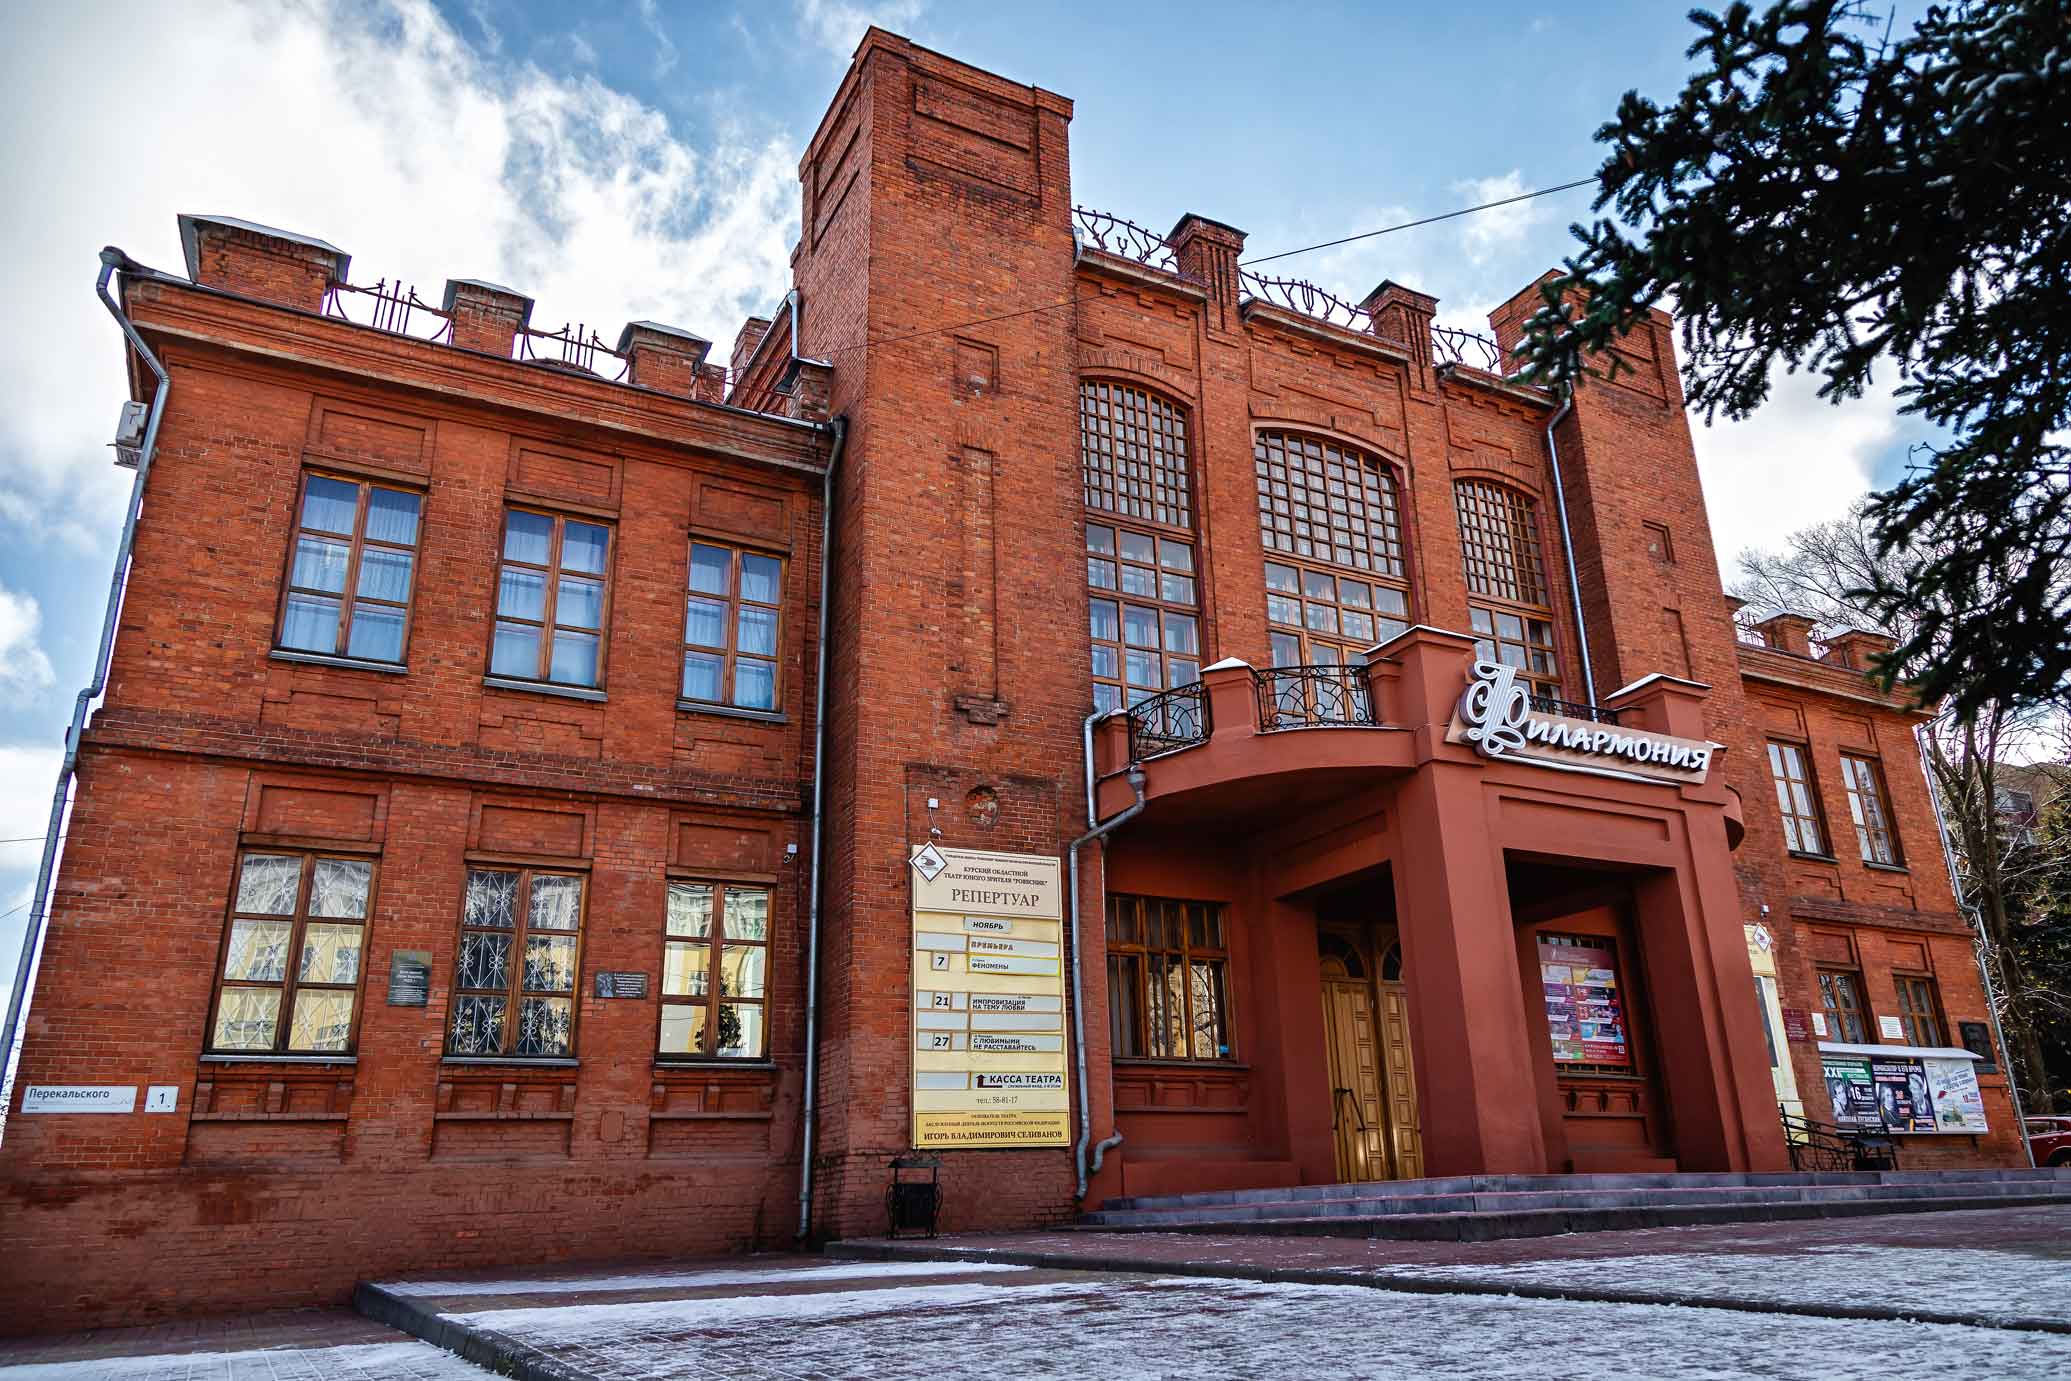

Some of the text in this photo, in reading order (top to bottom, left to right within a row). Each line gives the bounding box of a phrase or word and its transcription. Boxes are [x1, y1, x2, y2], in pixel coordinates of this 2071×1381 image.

[963, 866, 1029, 877] КУРСКИЙ ОБЛАСТНОЙ
[944, 872, 963, 880] ТЕАТР
[963, 874, 986, 882] ЮНОГО
[986, 876, 1012, 884] ЗРИТЕЛЯ
[952, 888, 1040, 908] РЕПЕРТУАР
[972, 921, 1004, 930] НОЯБРЬ
[971, 941, 1014, 951] ПРЕМЬЕРА
[937, 956, 945, 967] 7
[971, 962, 1009, 970] ФЕНОМЕНЫ
[935, 996, 949, 1006] 21
[934, 1036, 949, 1047] 27
[989, 1075, 1062, 1083] КАССА ТЕАТРА
[29, 1088, 165, 1104] Перекальского 1
[992, 1095, 1018, 1105] 58-81-17
[924, 1130, 1062, 1141] ИГОРЬ ВЛАДИМИРОВИЧ СЕЛИВАНОВ
